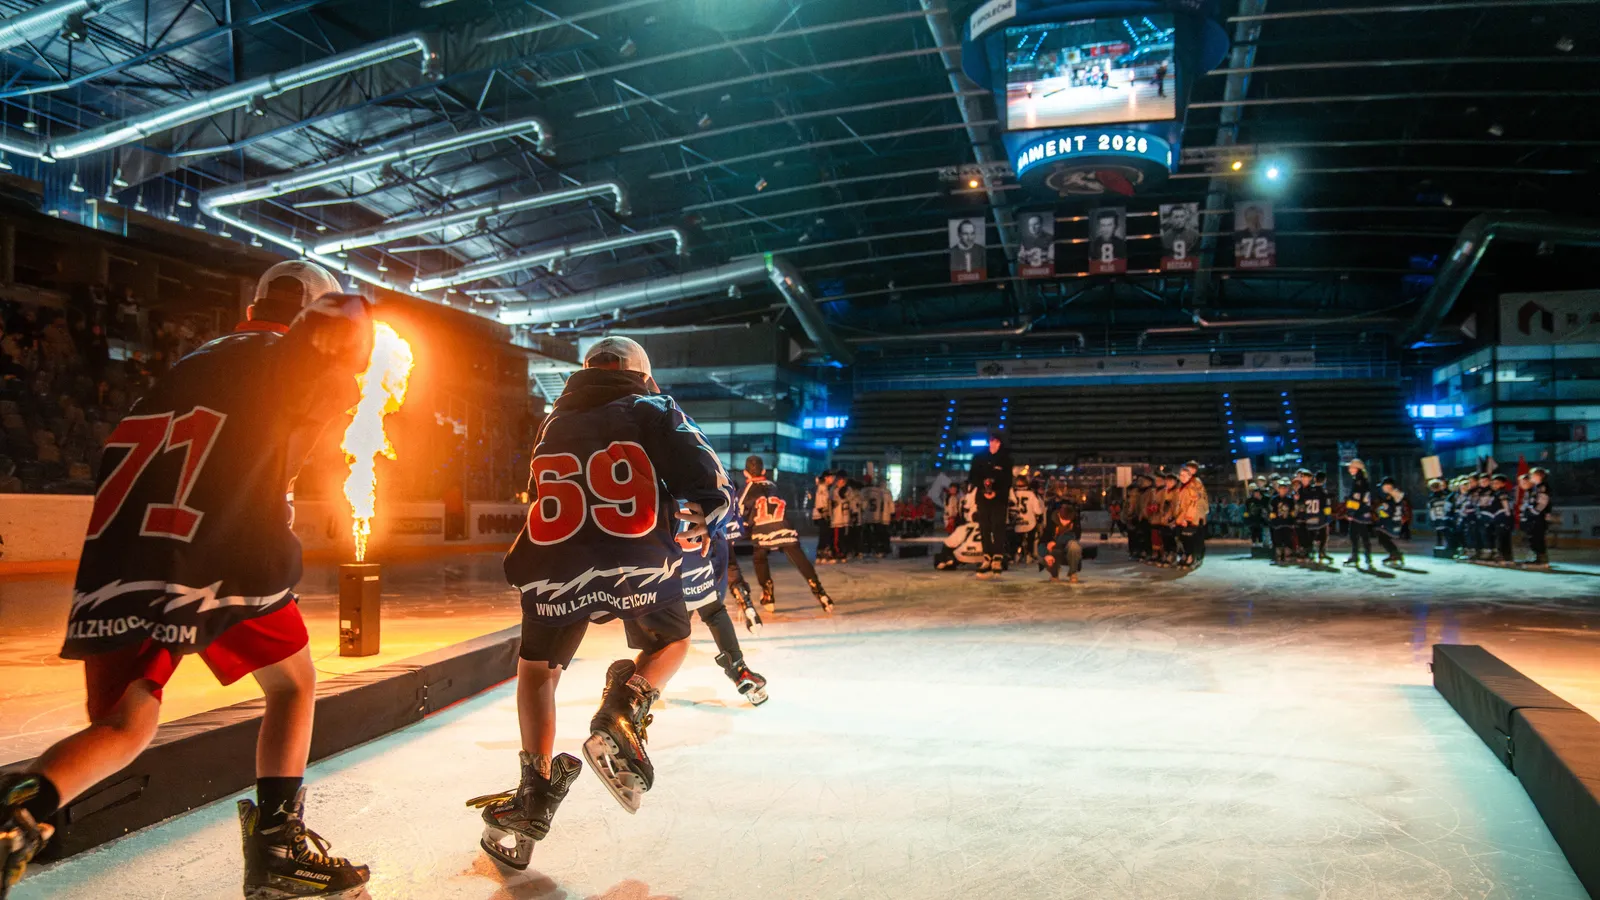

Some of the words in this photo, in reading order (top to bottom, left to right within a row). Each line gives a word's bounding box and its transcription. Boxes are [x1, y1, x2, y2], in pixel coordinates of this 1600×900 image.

[1098, 134, 1148, 153] 2026
[1101, 243, 1114, 263] 8
[1173, 240, 1186, 261] 9
[1241, 237, 1268, 259] 72
[84, 405, 228, 543] 71
[527, 440, 659, 545] 69
[754, 495, 787, 526] 17
[535, 591, 657, 617] WWW.LZHOCKEY.COM
[294, 868, 332, 882] BAUER
